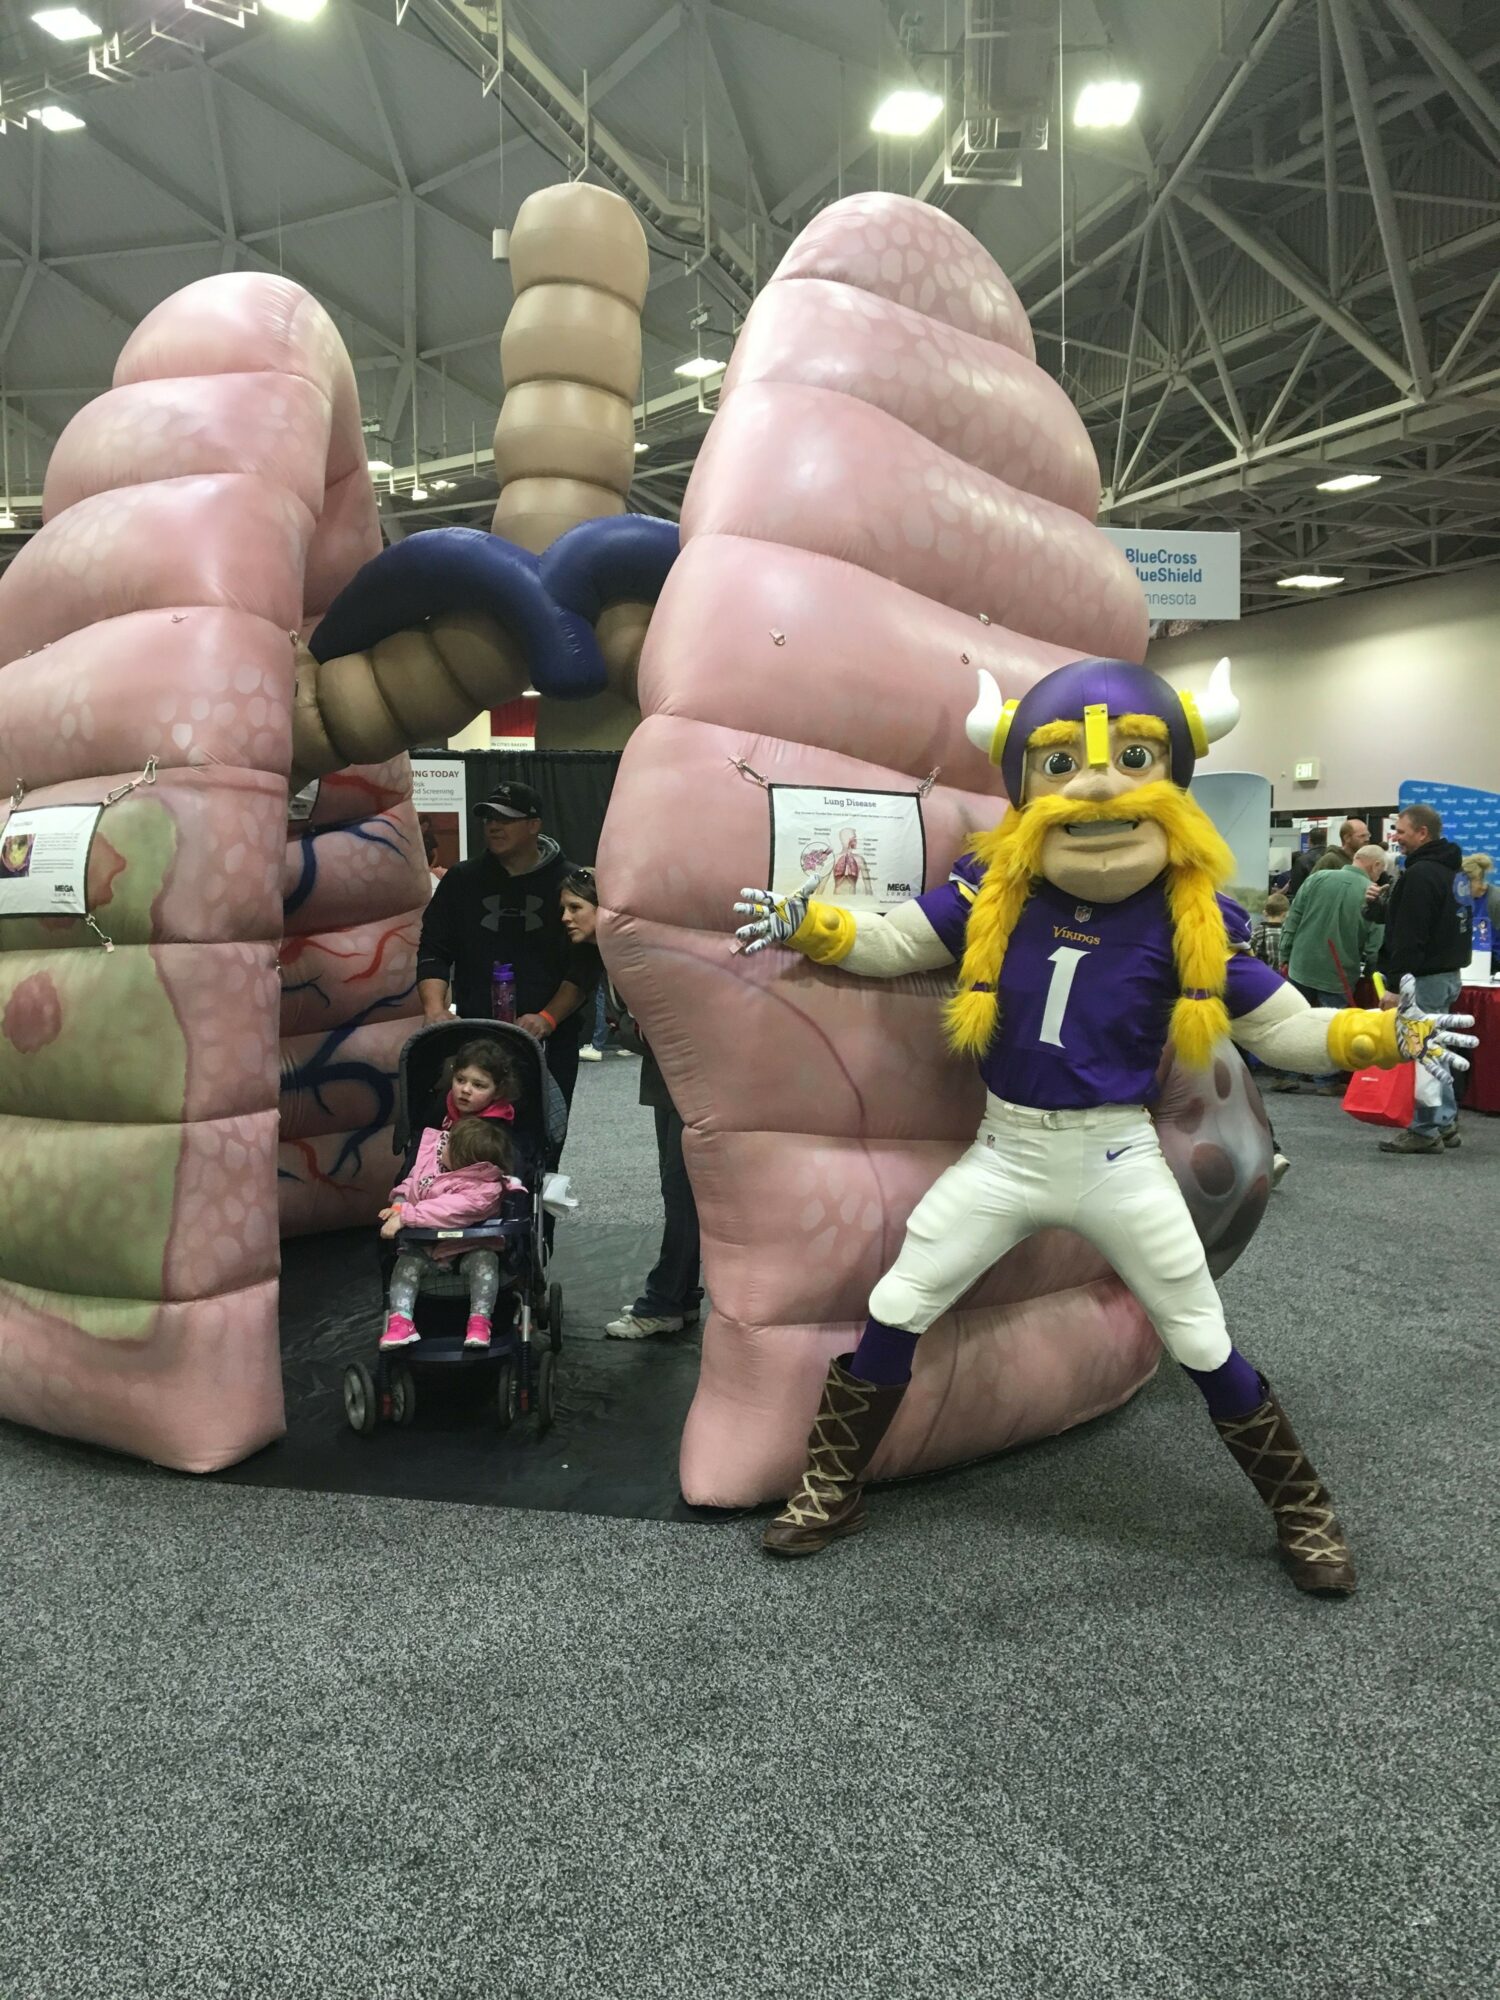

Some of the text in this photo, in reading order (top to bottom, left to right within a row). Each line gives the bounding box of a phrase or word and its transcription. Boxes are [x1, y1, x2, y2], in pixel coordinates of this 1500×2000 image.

[1125, 548, 1197, 564] BlueCross
[1136, 567, 1202, 583] lueShield
[1145, 593, 1197, 605] nnesota
[412, 770, 460, 778] ING TODAY
[422, 788, 455, 796] Screening
[823, 797, 877, 808] Lung Disease
[54, 885, 75, 893] MEGA
[887, 883, 911, 892] MEGA
[1039, 945, 1092, 1049] 1
